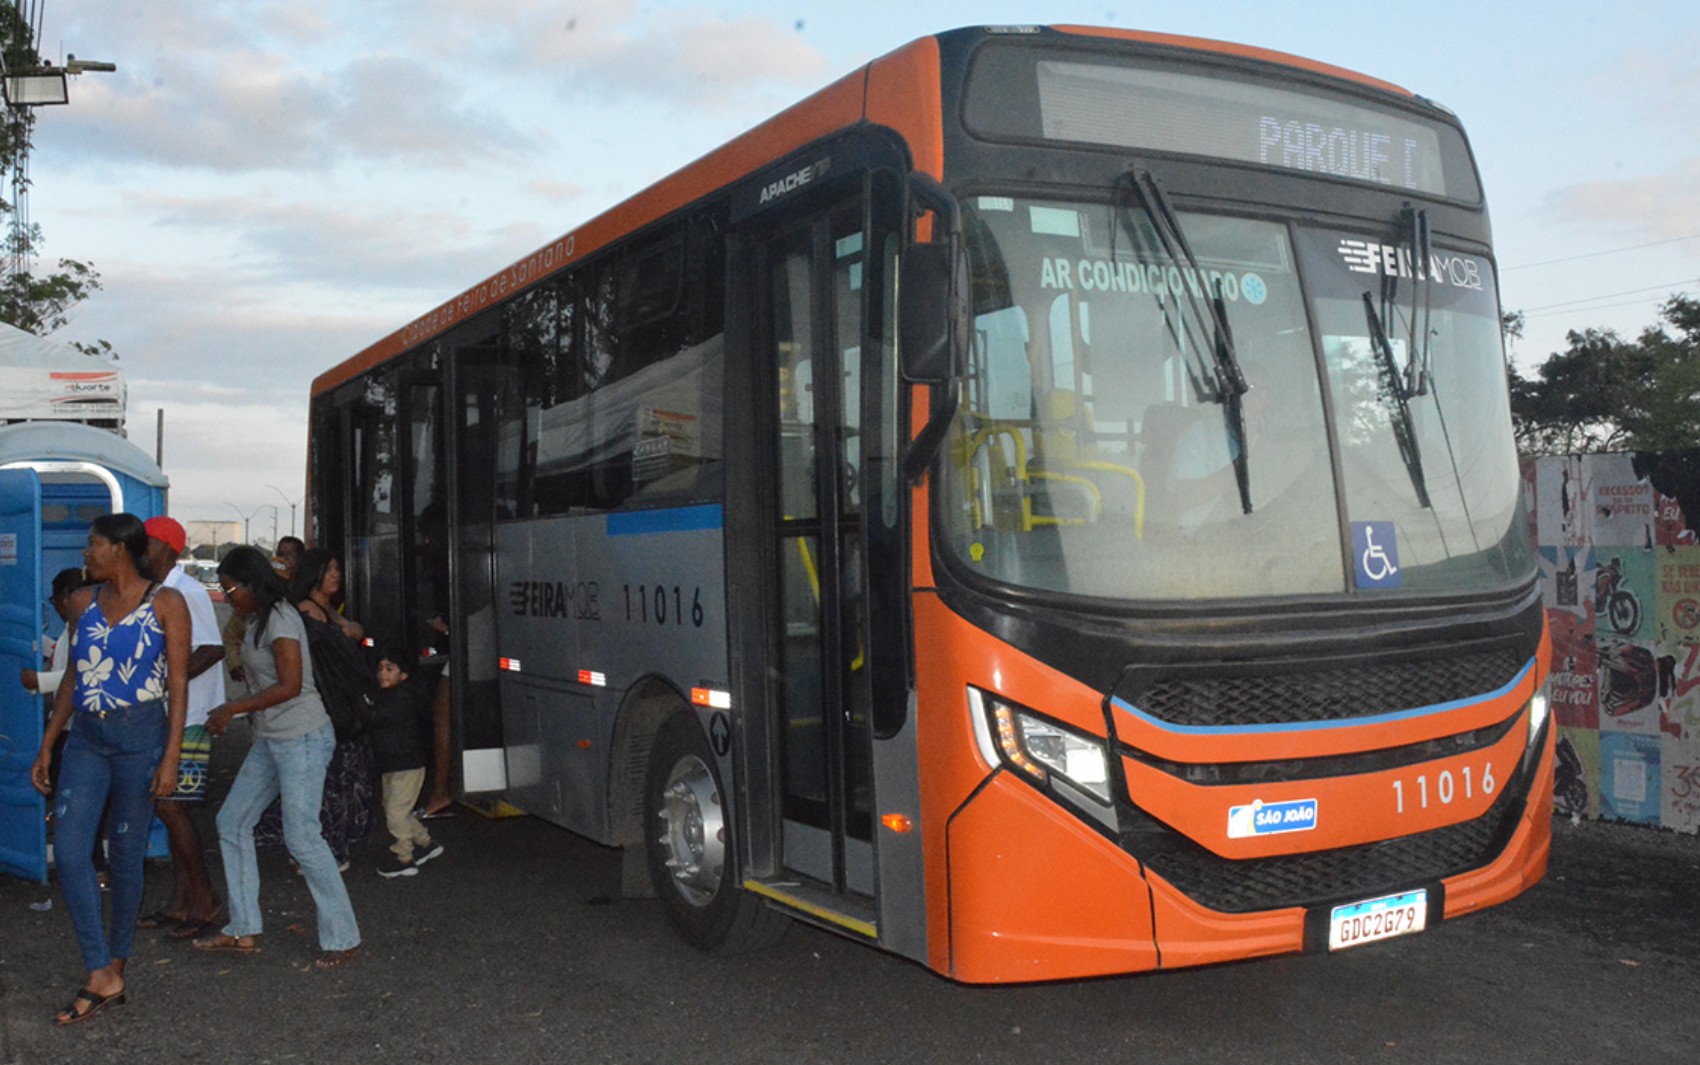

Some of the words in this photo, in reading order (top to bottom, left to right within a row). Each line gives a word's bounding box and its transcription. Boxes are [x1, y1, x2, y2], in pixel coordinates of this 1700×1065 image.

[1260, 116, 1391, 184] PARQUE
[760, 166, 813, 204] APACHE
[510, 236, 575, 288] Santana
[1041, 258, 1073, 290] AR
[624, 584, 704, 628] 11016
[1393, 762, 1496, 814] 11016
[1256, 809, 1282, 826] SÃO
[1283, 806, 1314, 823] JOÃO
[1340, 906, 1416, 943] GDC2G79
